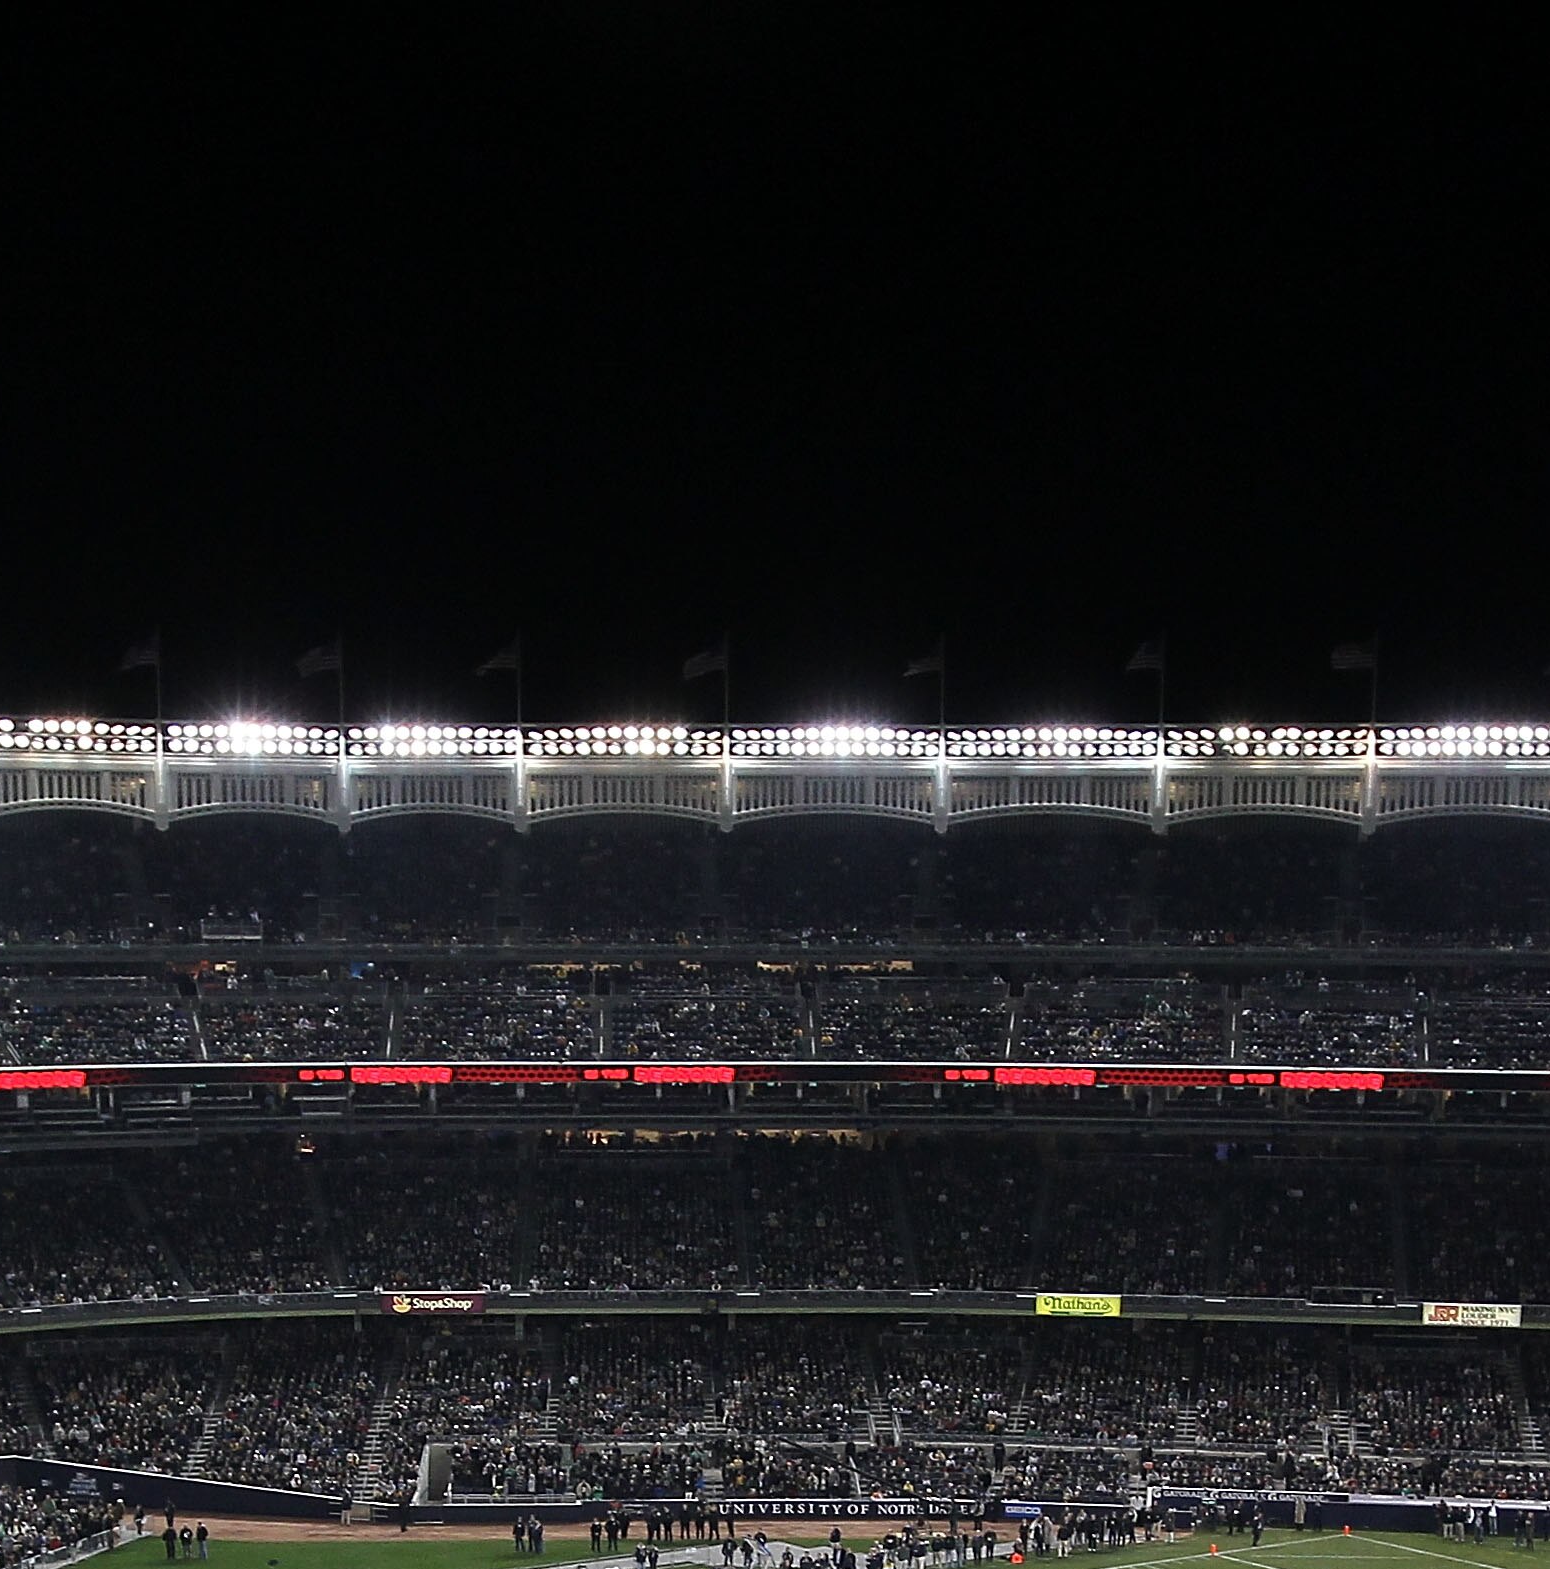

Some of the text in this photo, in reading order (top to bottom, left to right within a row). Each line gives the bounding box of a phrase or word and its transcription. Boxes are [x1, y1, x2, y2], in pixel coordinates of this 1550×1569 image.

[412, 1297, 472, 1311] Stop&Shop
[718, 1503, 842, 1516] UNIVERSITY
[847, 1504, 870, 1515] OF
